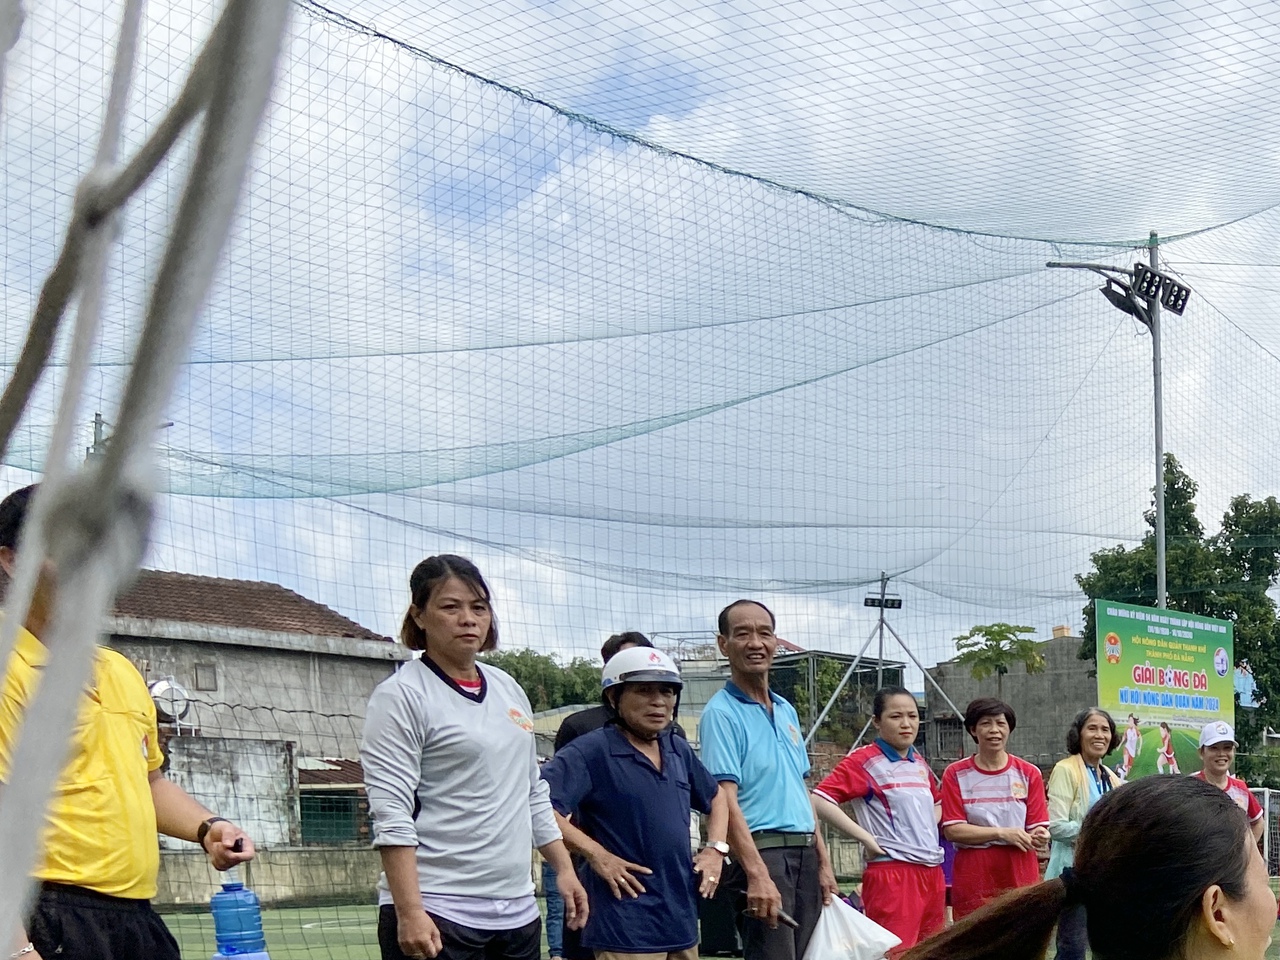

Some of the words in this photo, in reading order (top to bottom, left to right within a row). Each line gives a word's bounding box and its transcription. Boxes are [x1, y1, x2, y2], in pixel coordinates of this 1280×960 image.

[1132, 635, 1141, 645] HỘI
[1142, 637, 1156, 647] NÔNG
[1157, 638, 1168, 648] DÂN
[1146, 649, 1161, 659] THÀNH
[1133, 661, 1155, 685] GIẢI
[1158, 666, 1189, 688] BÓNG
[1193, 670, 1207, 690] ĐÁ
[1119, 687, 1129, 703] NỮ
[1130, 688, 1140, 705] HỘI
[1143, 690, 1159, 706] NÔNG
[1161, 691, 1173, 707] DÂN
[1175, 692, 1190, 709] QUẬN
[1191, 694, 1204, 709] NĂM
[1205, 696, 1219, 710] 2024
